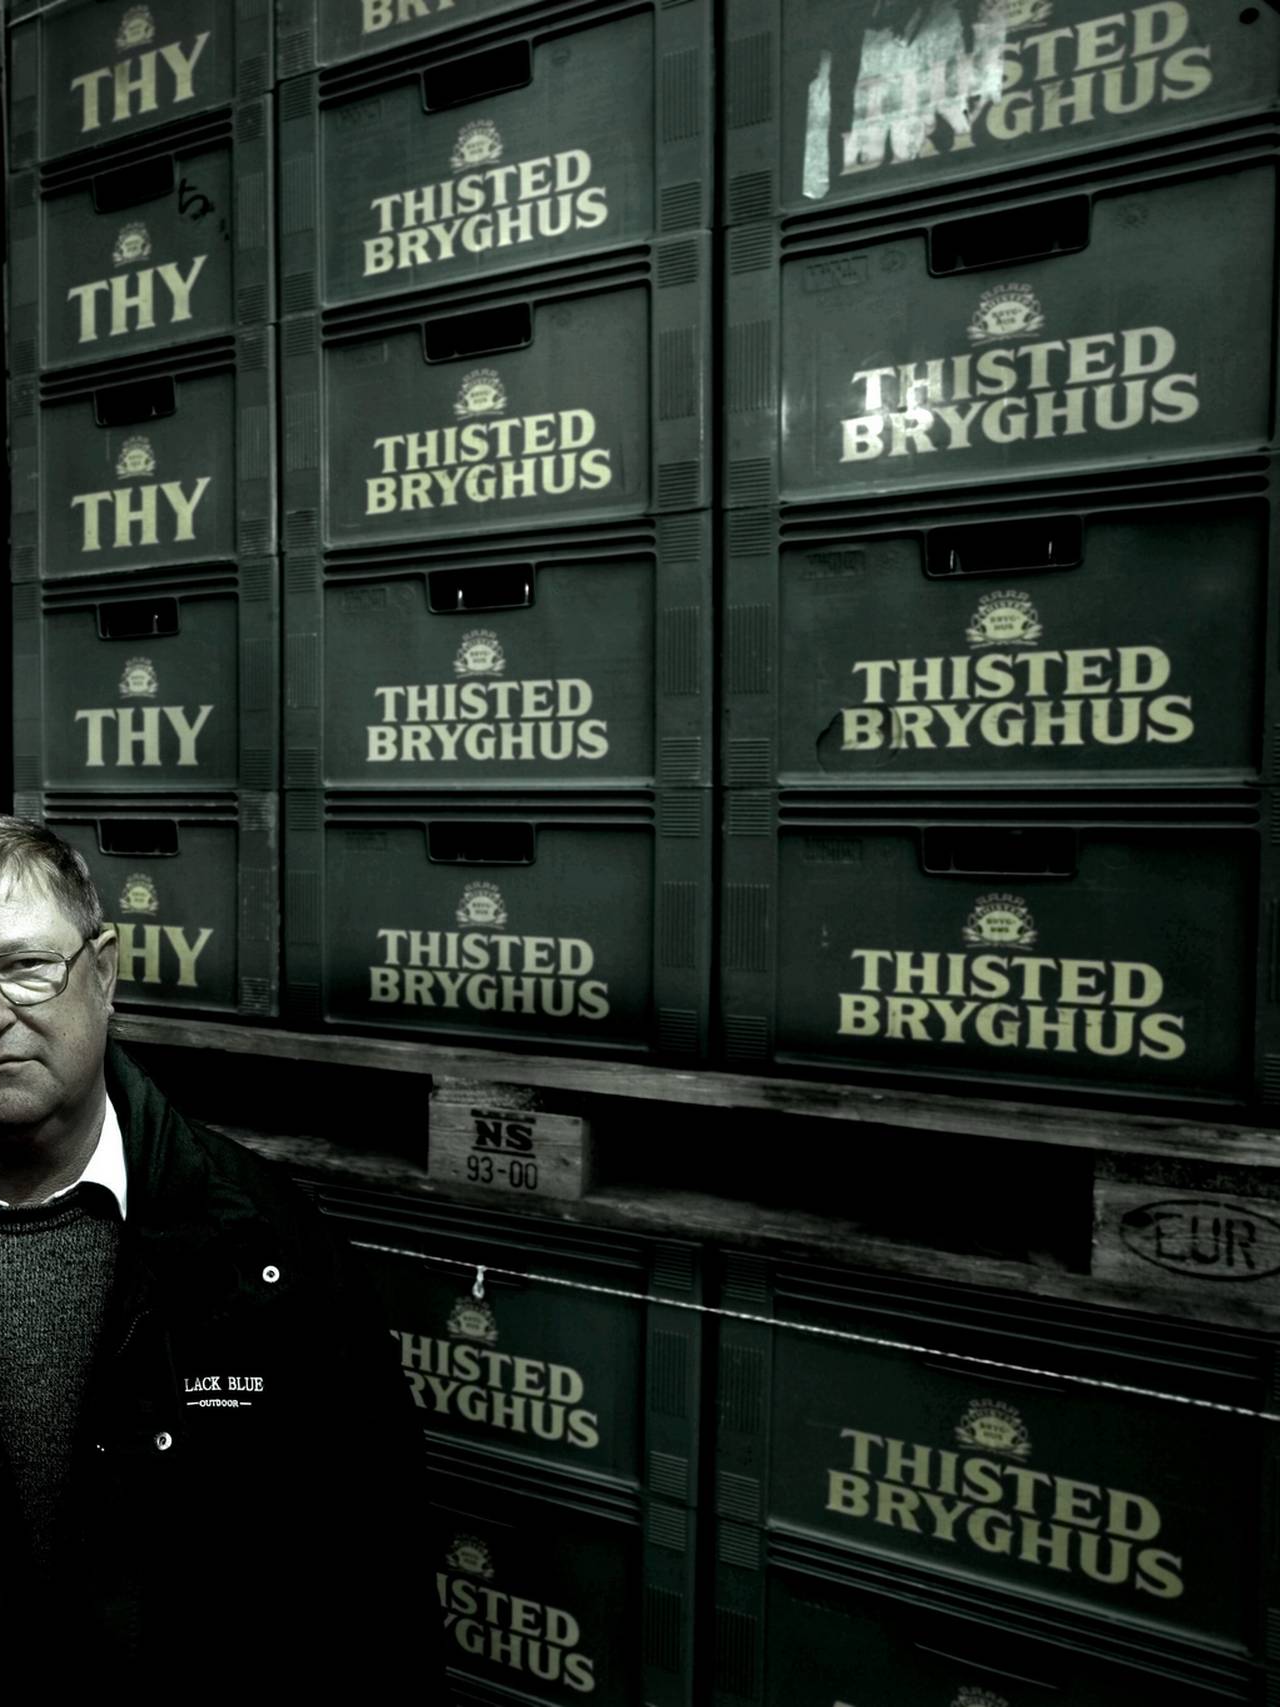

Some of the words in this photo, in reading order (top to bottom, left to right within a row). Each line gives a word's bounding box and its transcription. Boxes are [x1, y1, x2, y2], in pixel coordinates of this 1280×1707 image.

[70, 31, 210, 133] THY
[370, 148, 591, 233] THISTED
[362, 187, 608, 277] BRYGHUS
[67, 254, 208, 343] THY
[852, 326, 1177, 411] THISTED
[373, 408, 596, 474] THISTED
[840, 373, 1200, 463] BRYGHUS
[72, 476, 211, 551] THY
[365, 449, 612, 515] BRYGHUS
[374, 678, 592, 722] THISTED
[852, 646, 1171, 704] THISTED
[75, 705, 215, 767] THY
[365, 719, 608, 762] BRYGHUS
[840, 695, 1195, 751] BRYGHUS
[101, 922, 214, 987] HY
[376, 928, 594, 977] THISTED
[850, 949, 1164, 1008] THISTED
[369, 966, 611, 1021] BRYGHUS
[838, 994, 1186, 1062] BRYGHUS
[475, 1120, 532, 1151] NS
[467, 1155, 537, 1190] 93-00
[1154, 1212, 1255, 1269] EUR
[184, 1376, 222, 1392] LACK
[227, 1376, 264, 1392] BLUE
[389, 1329, 584, 1405] HISTED
[200, 1399, 239, 1407] OUTDOOR
[403, 1369, 599, 1449] RYGHUS
[840, 1429, 1163, 1545] THISTED
[825, 1468, 1185, 1601] BRYGHUS
[444, 1612, 596, 1692] GHUS
